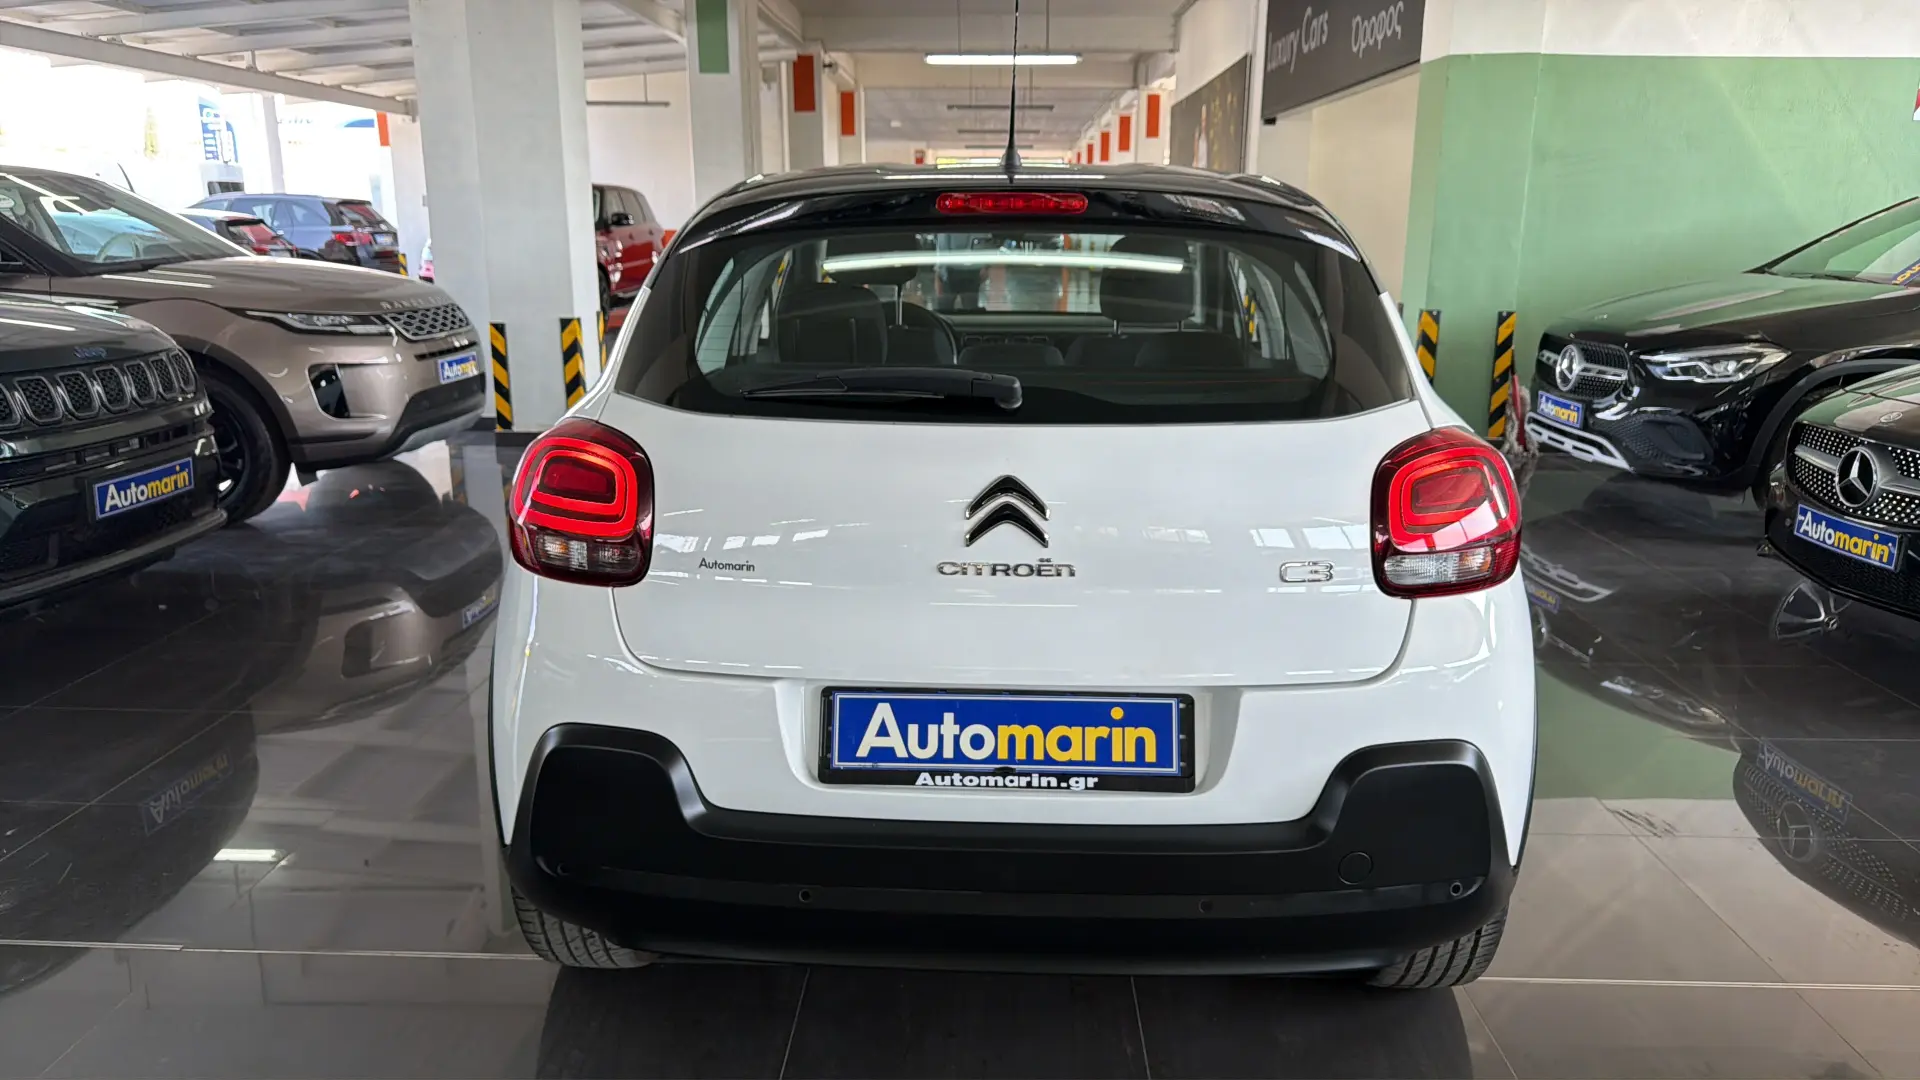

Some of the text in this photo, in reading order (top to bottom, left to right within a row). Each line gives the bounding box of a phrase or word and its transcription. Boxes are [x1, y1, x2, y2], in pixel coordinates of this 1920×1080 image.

[1267, 6, 1328, 73] Luxury Cars
[104, 465, 189, 512] Automarin
[1800, 510, 1890, 563] Automarin
[699, 557, 756, 572] Automarin
[936, 557, 1076, 577] CITROËN
[1279, 561, 1334, 583] C3
[855, 702, 1157, 763] Automarin
[914, 772, 1099, 790] Automarin.gr
